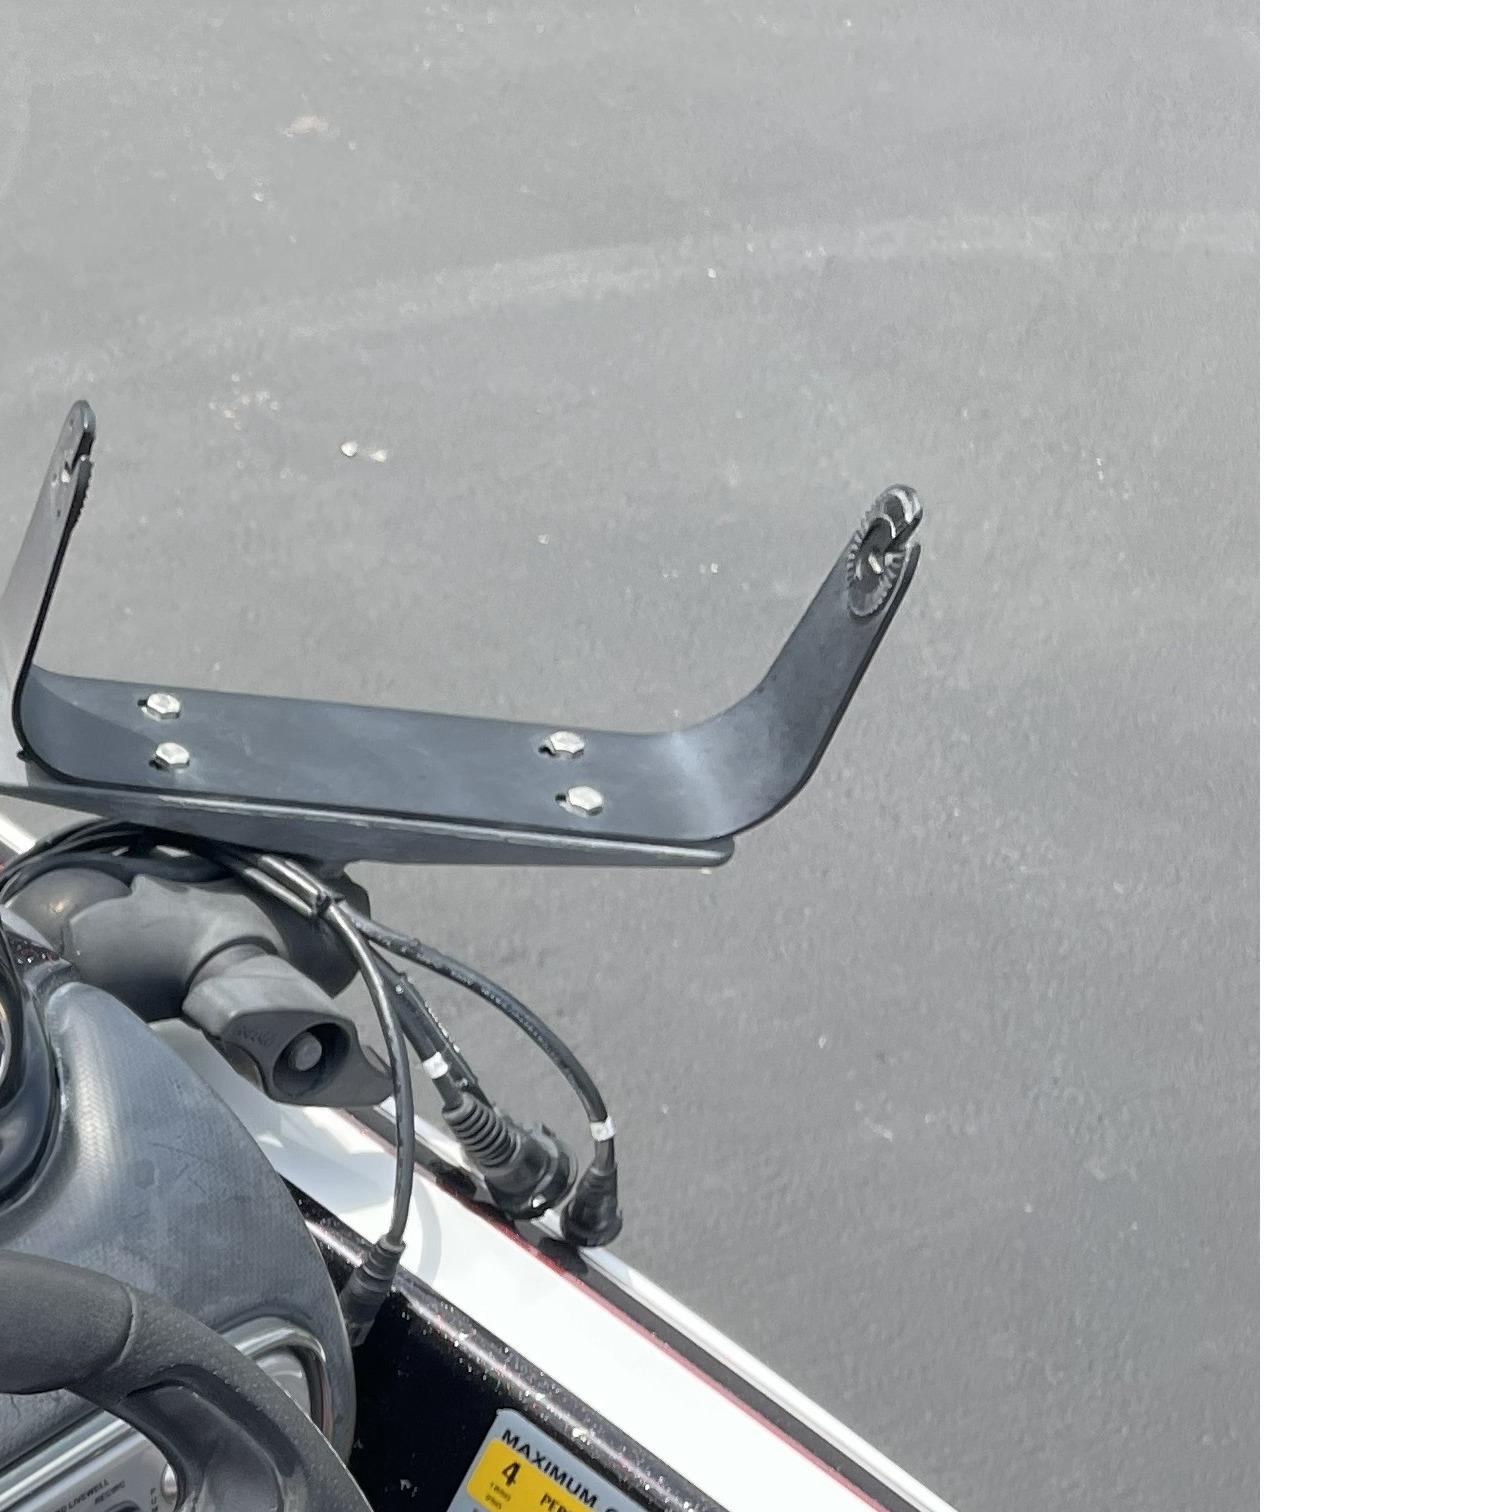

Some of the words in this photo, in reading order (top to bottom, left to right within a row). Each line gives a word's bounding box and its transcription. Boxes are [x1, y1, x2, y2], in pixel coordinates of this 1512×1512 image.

[501, 1428, 599, 1509] MAXIMUM
[501, 1461, 521, 1487] 4
[67, 1478, 111, 1511] LIVEWELL
